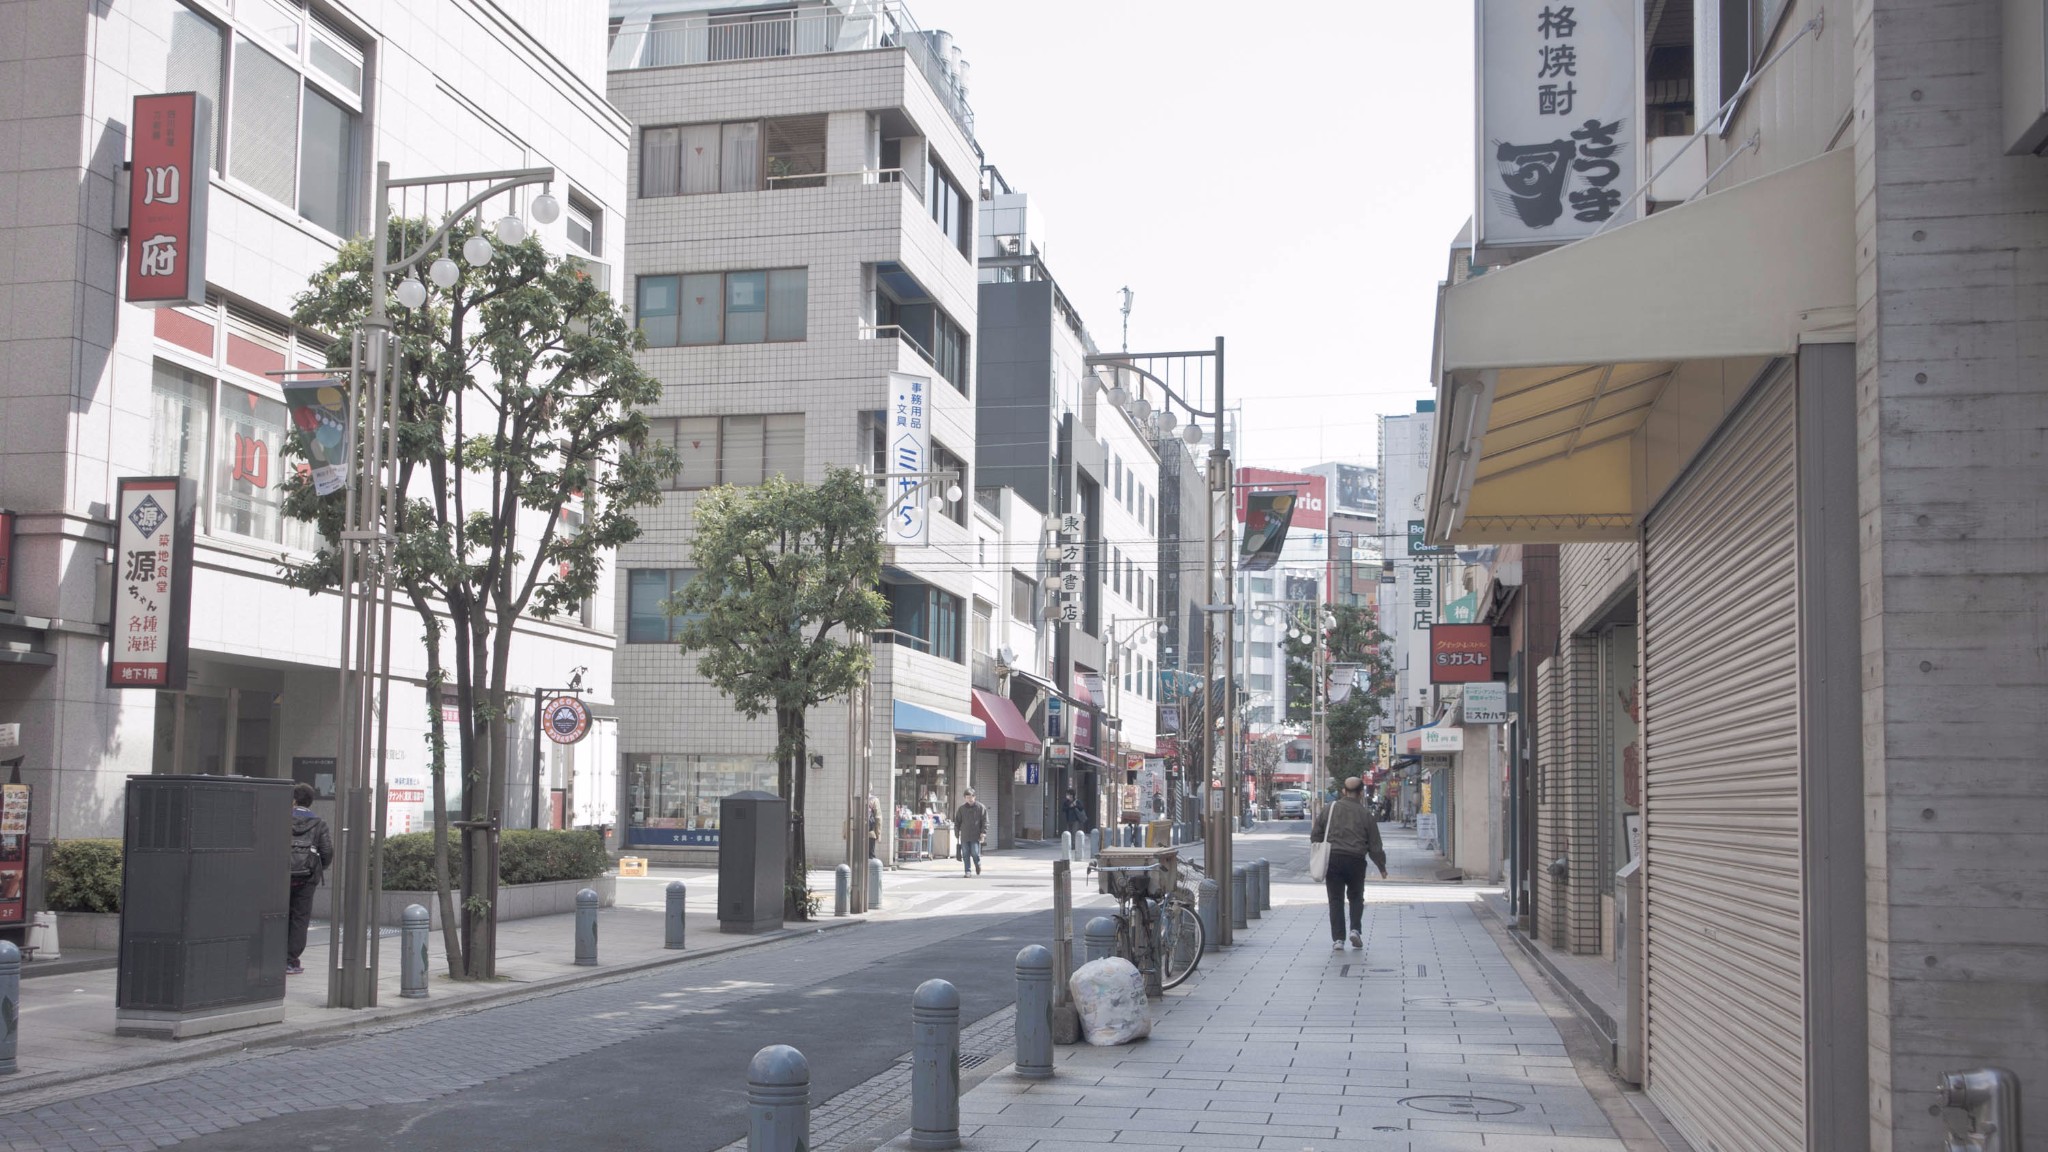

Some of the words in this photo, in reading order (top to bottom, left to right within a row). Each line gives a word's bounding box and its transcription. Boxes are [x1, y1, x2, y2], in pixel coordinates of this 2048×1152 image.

[1537, 5, 1577, 116] 格焼酎
[139, 164, 180, 276] 川府
[910, 382, 922, 429] 事務用品
[125, 550, 158, 612] 源ちゃん
[156, 534, 170, 593] 築地食堂
[1061, 515, 1080, 621] 東方書店
[127, 635, 158, 652] 海鮮
[128, 615, 158, 633] 各種
[122, 667, 159, 680] 地下1階
